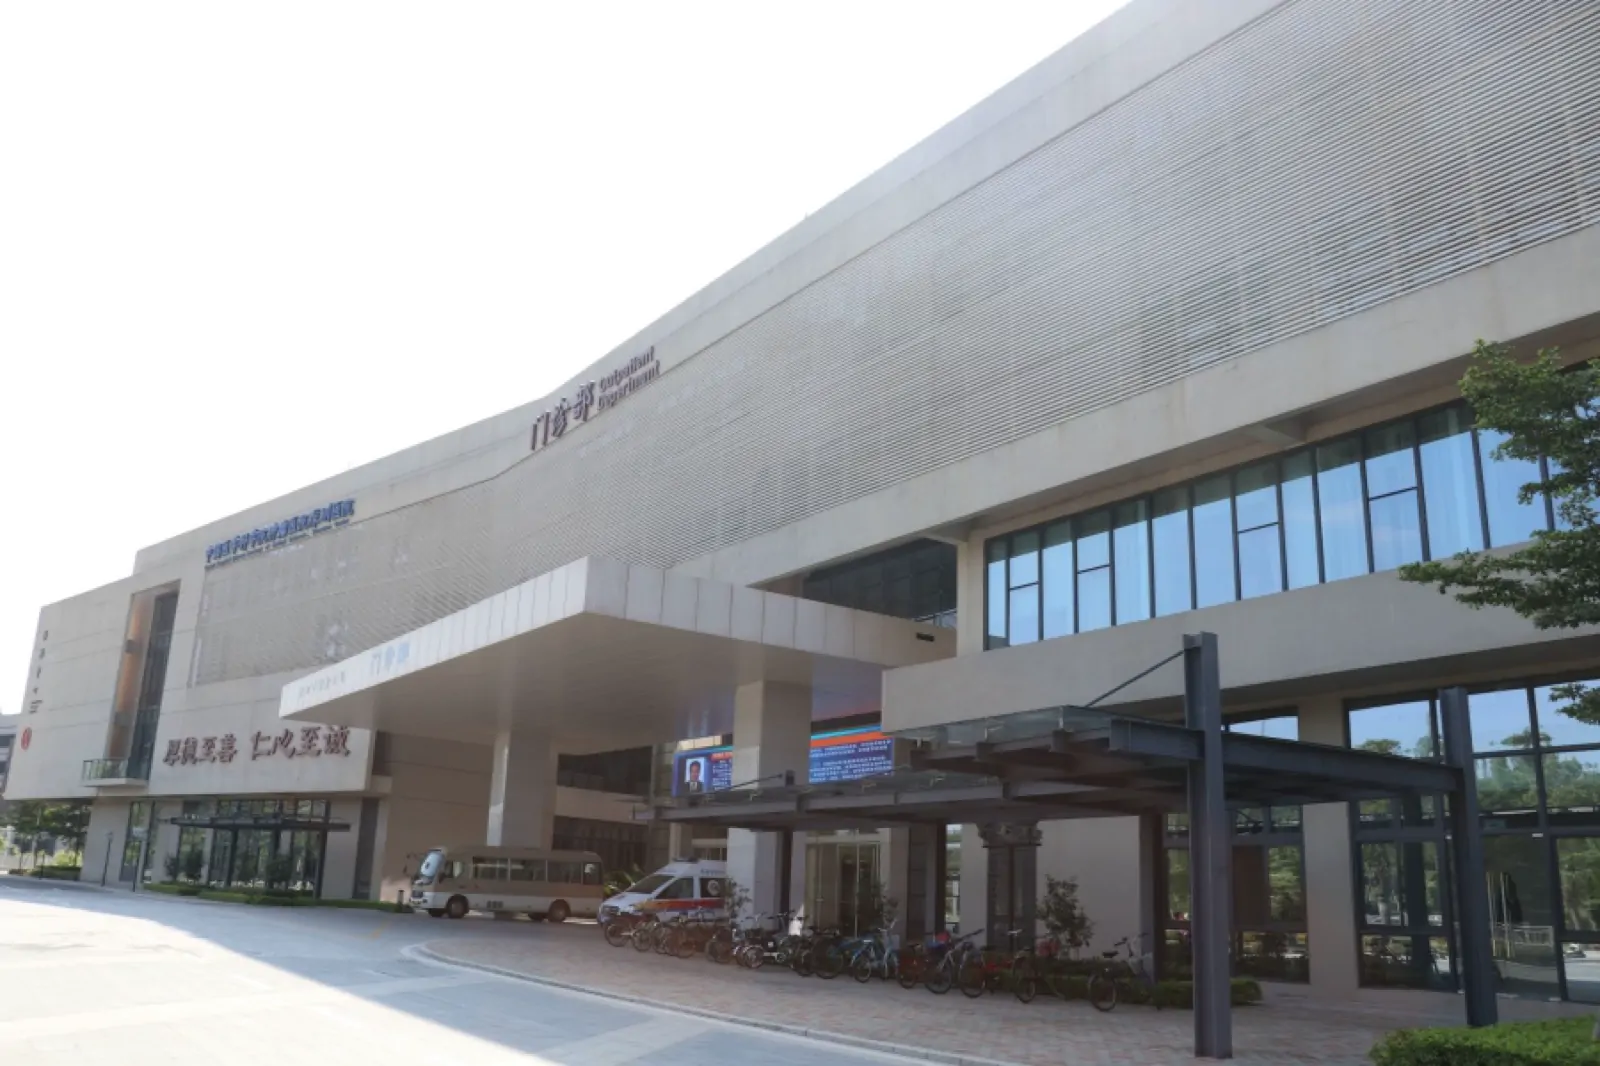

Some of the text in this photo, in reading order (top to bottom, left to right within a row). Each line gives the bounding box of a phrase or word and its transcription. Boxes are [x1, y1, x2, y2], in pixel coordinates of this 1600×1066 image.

[598, 360, 661, 410] Department
[600, 345, 655, 392] Outpatient
[530, 380, 595, 451] 门诊部
